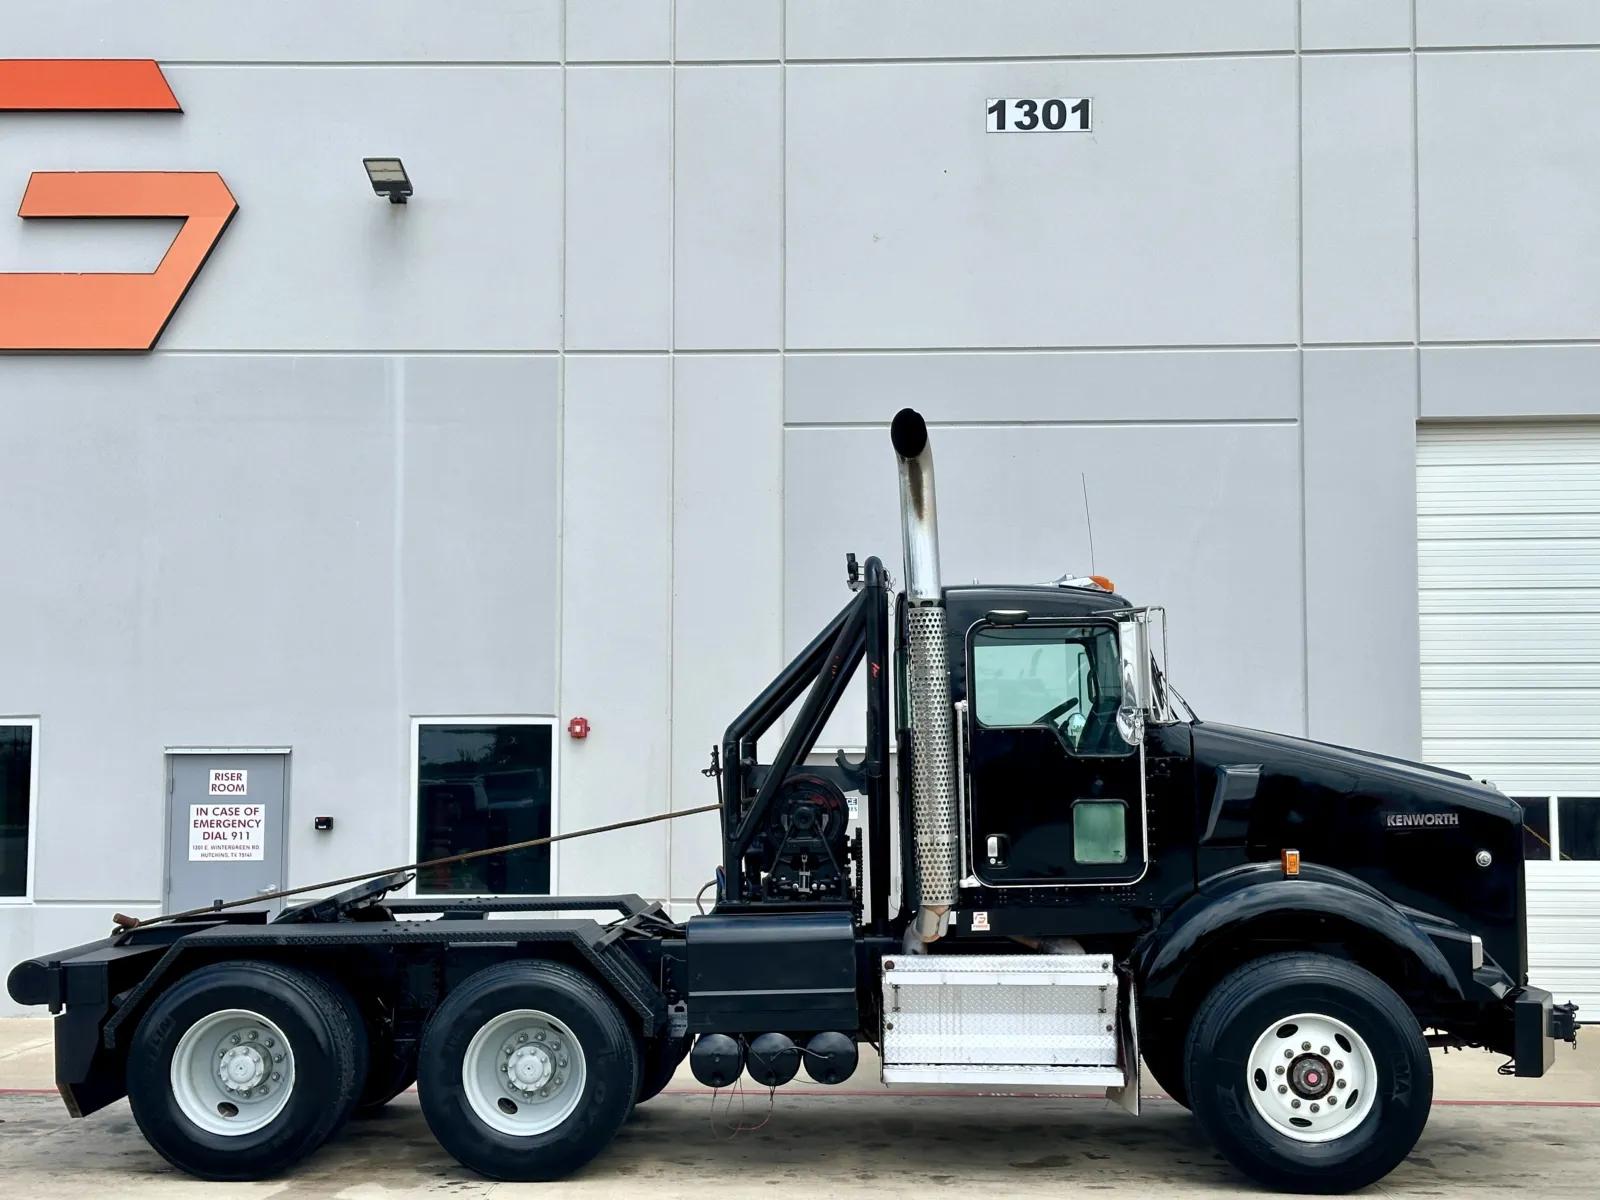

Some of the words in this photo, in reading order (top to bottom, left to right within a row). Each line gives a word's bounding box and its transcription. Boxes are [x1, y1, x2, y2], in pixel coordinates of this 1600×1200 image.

[988, 99, 1090, 131] 1301
[214, 772, 243, 781] RISER
[211, 783, 245, 792] ROOM
[196, 807, 209, 816] IN
[212, 807, 240, 816] CASE
[244, 807, 260, 816] OF
[193, 819, 261, 828] EMERGENCY
[1386, 813, 1459, 826] KENWORTH
[202, 831, 228, 840] DIAL
[231, 831, 250, 840] 911
